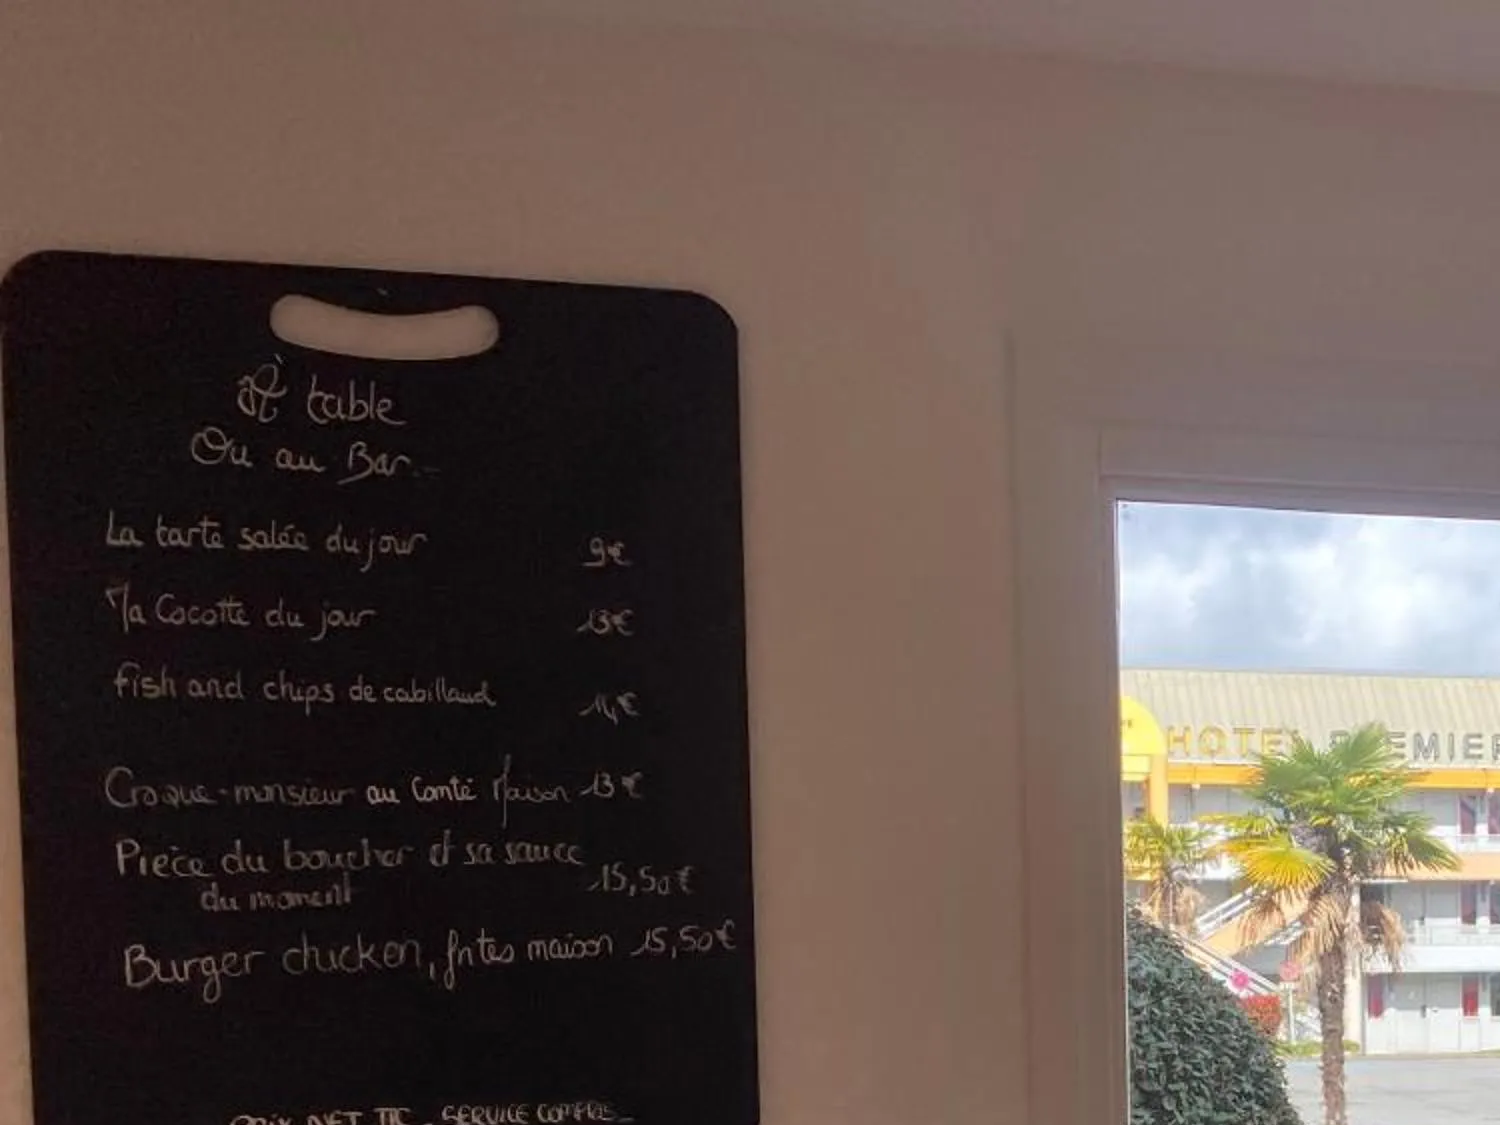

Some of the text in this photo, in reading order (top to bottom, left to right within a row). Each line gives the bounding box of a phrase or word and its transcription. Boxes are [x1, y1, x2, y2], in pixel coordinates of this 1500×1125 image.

[306, 373, 408, 425] table
[190, 426, 254, 468] Ou
[275, 447, 326, 473] au
[104, 510, 144, 547] La
[155, 514, 224, 550] tarte
[237, 519, 310, 552] salée
[325, 523, 360, 554] du
[358, 528, 428, 573] jour
[153, 591, 252, 628] Cocotte
[265, 597, 304, 628] du
[308, 600, 379, 643] jour
[186, 670, 245, 701] and
[262, 669, 334, 717] chips
[348, 673, 378, 703] de
[382, 675, 497, 707] cabillaud
[1166, 724, 1303, 758] HOTE
[366, 783, 400, 806] au
[220, 838, 270, 875] du
[283, 837, 415, 872] boucher
[463, 843, 492, 867] sa
[500, 842, 585, 868] sauce
[199, 871, 357, 912] du moment
[122, 943, 265, 1004] Burger
[443, 928, 514, 990] frites
[527, 933, 614, 961] maison
